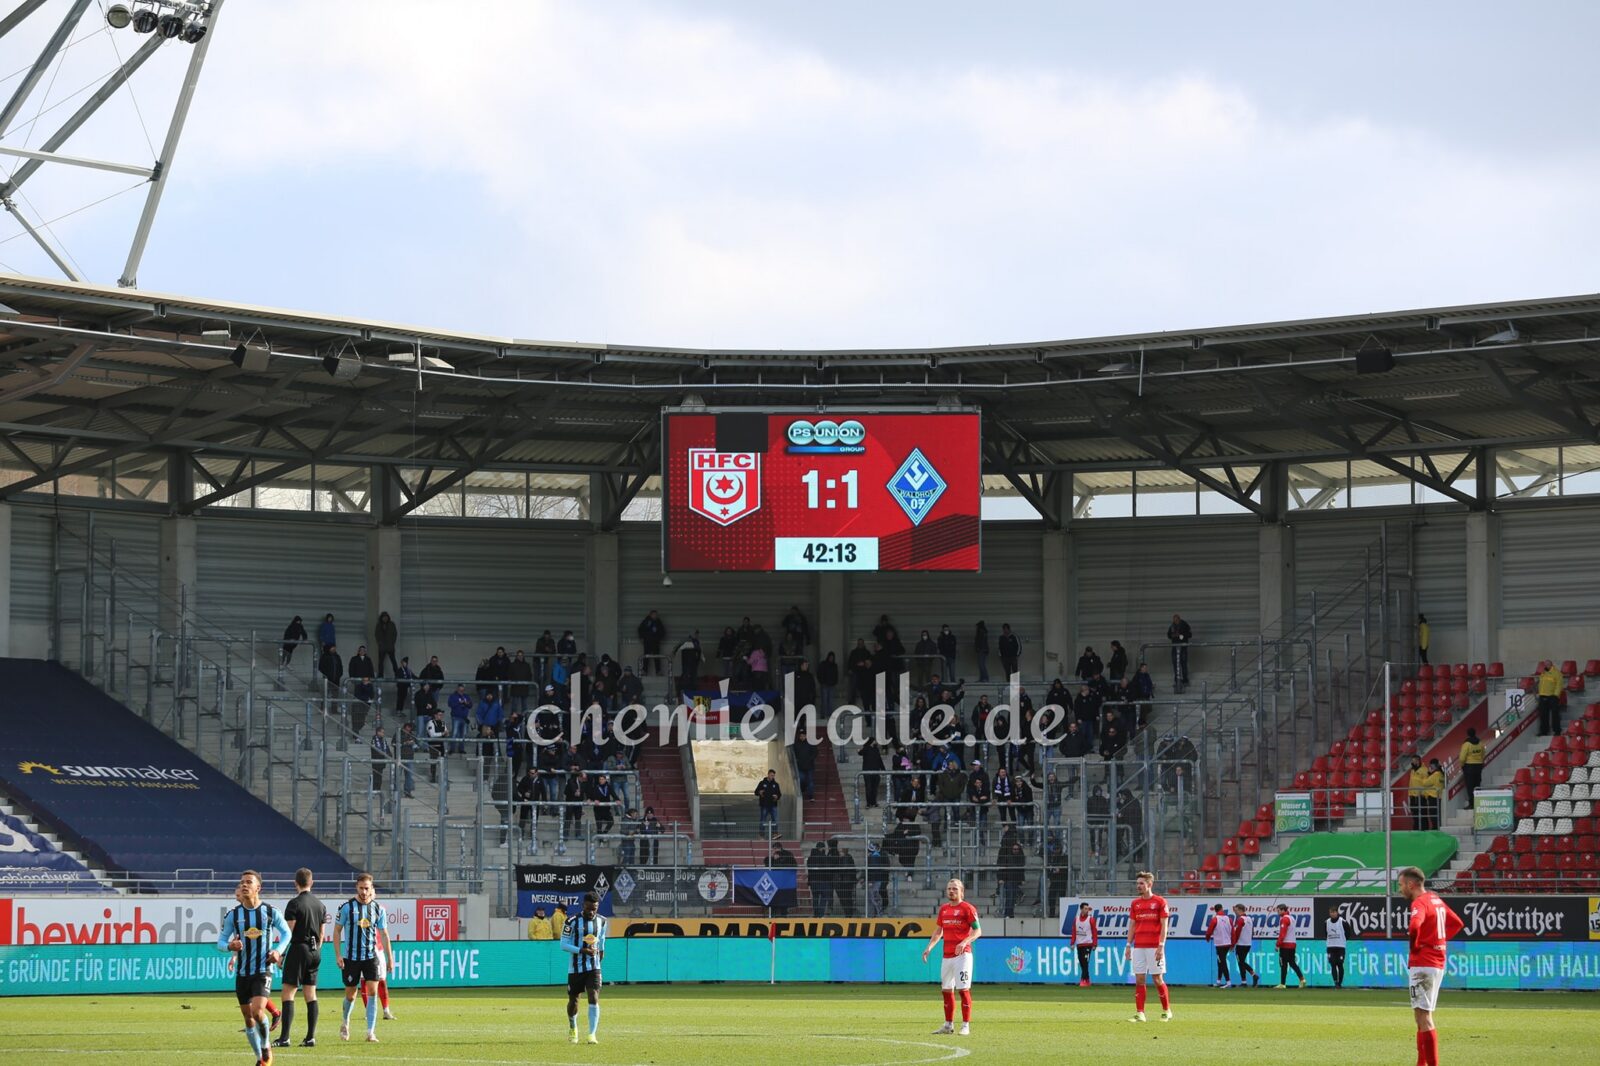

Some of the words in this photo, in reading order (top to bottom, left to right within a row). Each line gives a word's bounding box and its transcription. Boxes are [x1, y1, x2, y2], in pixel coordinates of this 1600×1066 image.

[792, 427, 812, 438] PS
[815, 427, 861, 438] UNION
[697, 453, 752, 468] HFC
[801, 469, 858, 509] 1:1
[910, 498, 926, 510] 07
[802, 542, 857, 563] 42:13
[61, 765, 199, 781] sunmaker
[523, 872, 557, 884] WALDHOF
[565, 873, 587, 885] FANS
[645, 889, 688, 902] Mannhim
[386, 908, 410, 924] olle
[426, 908, 448, 918] HFC
[1463, 901, 1564, 937] Köstritzer
[9, 953, 71, 983] GRÜNDE
[75, 952, 103, 982] FÜR
[109, 958, 141, 982] EINE
[145, 956, 236, 981] AUSBILDUNG
[392, 949, 434, 980] HIGH
[440, 949, 480, 979] FIVE
[1349, 948, 1379, 975] FÜR
[1384, 953, 1409, 976] EIN
[1537, 955, 1554, 977] IN
[959, 970, 968, 981] 26
